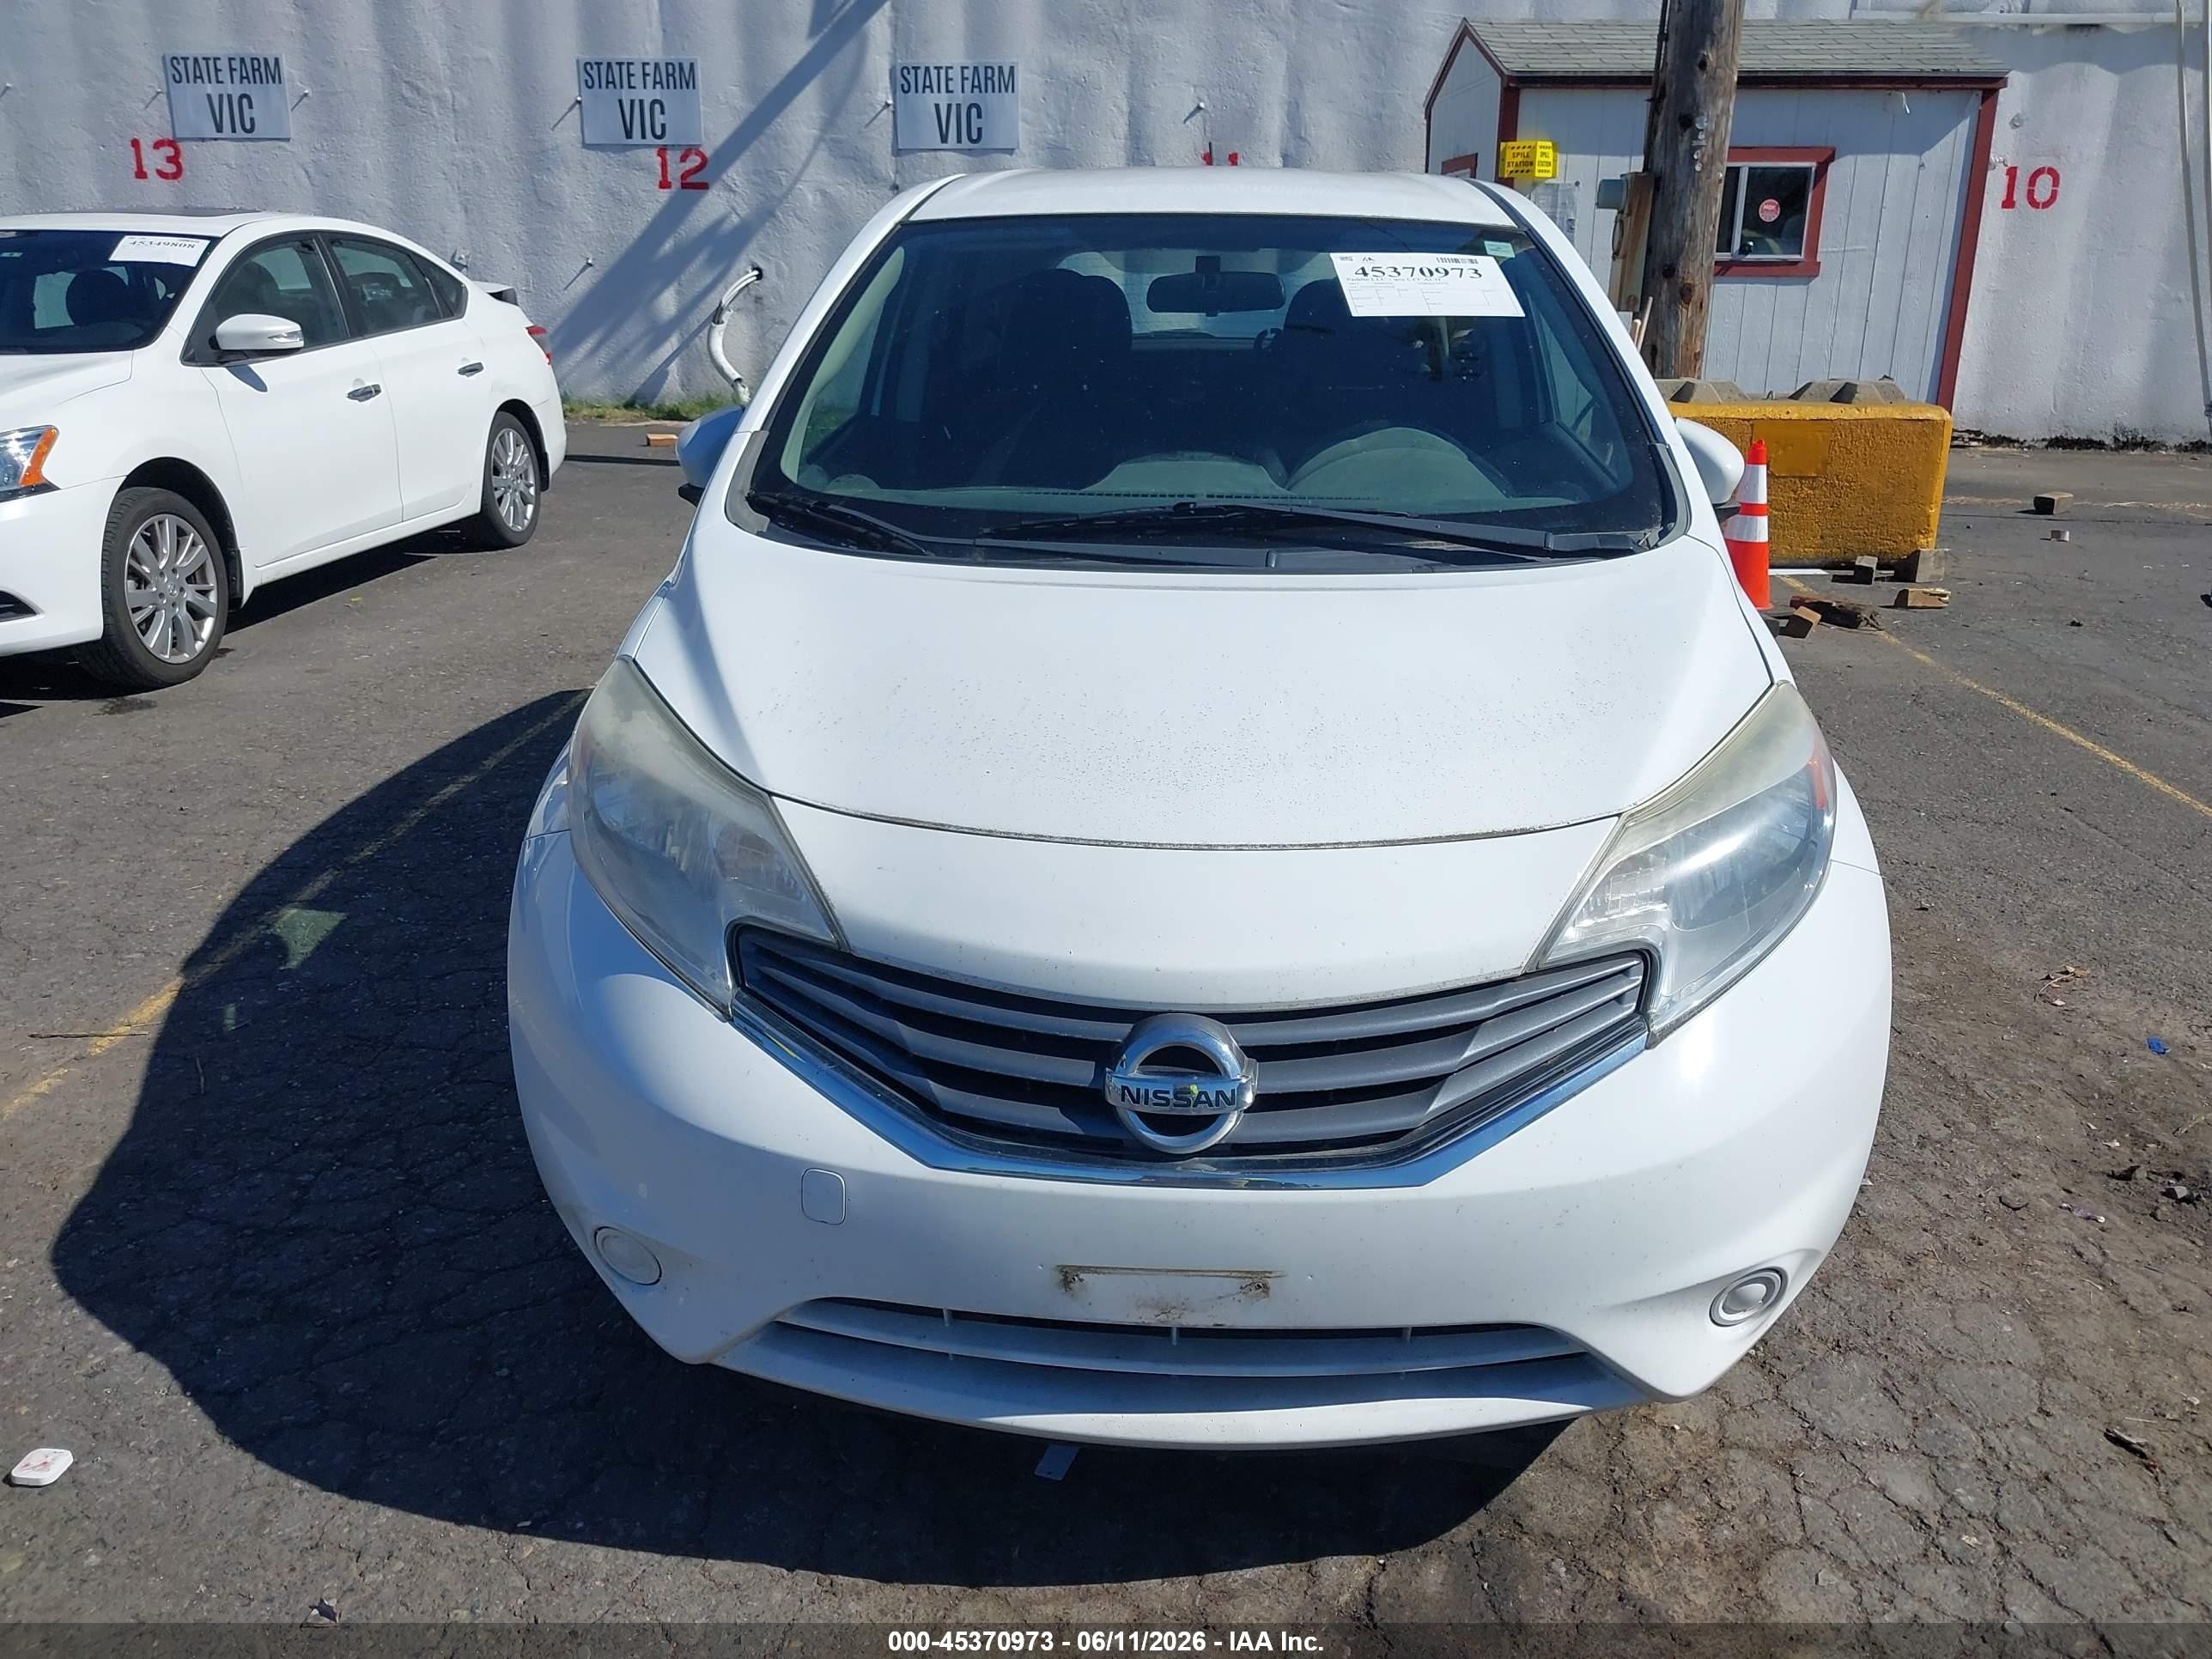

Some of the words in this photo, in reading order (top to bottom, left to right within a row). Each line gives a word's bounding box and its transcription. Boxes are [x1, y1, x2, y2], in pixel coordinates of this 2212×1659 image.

[170, 56, 224, 84] STATE
[228, 57, 283, 85] FARM
[583, 61, 636, 90] STATE
[641, 62, 696, 90] FARM
[900, 65, 954, 94] STATE
[960, 65, 1015, 94] FARM
[206, 93, 256, 134] VIC
[618, 98, 666, 140] VIC
[934, 102, 983, 144] VIC
[131, 137, 184, 180] 13
[657, 147, 709, 190] 12
[2001, 166, 2060, 210] 10
[1354, 266, 1483, 279] 45370973
[1121, 1085, 1236, 1109] NISSAN
